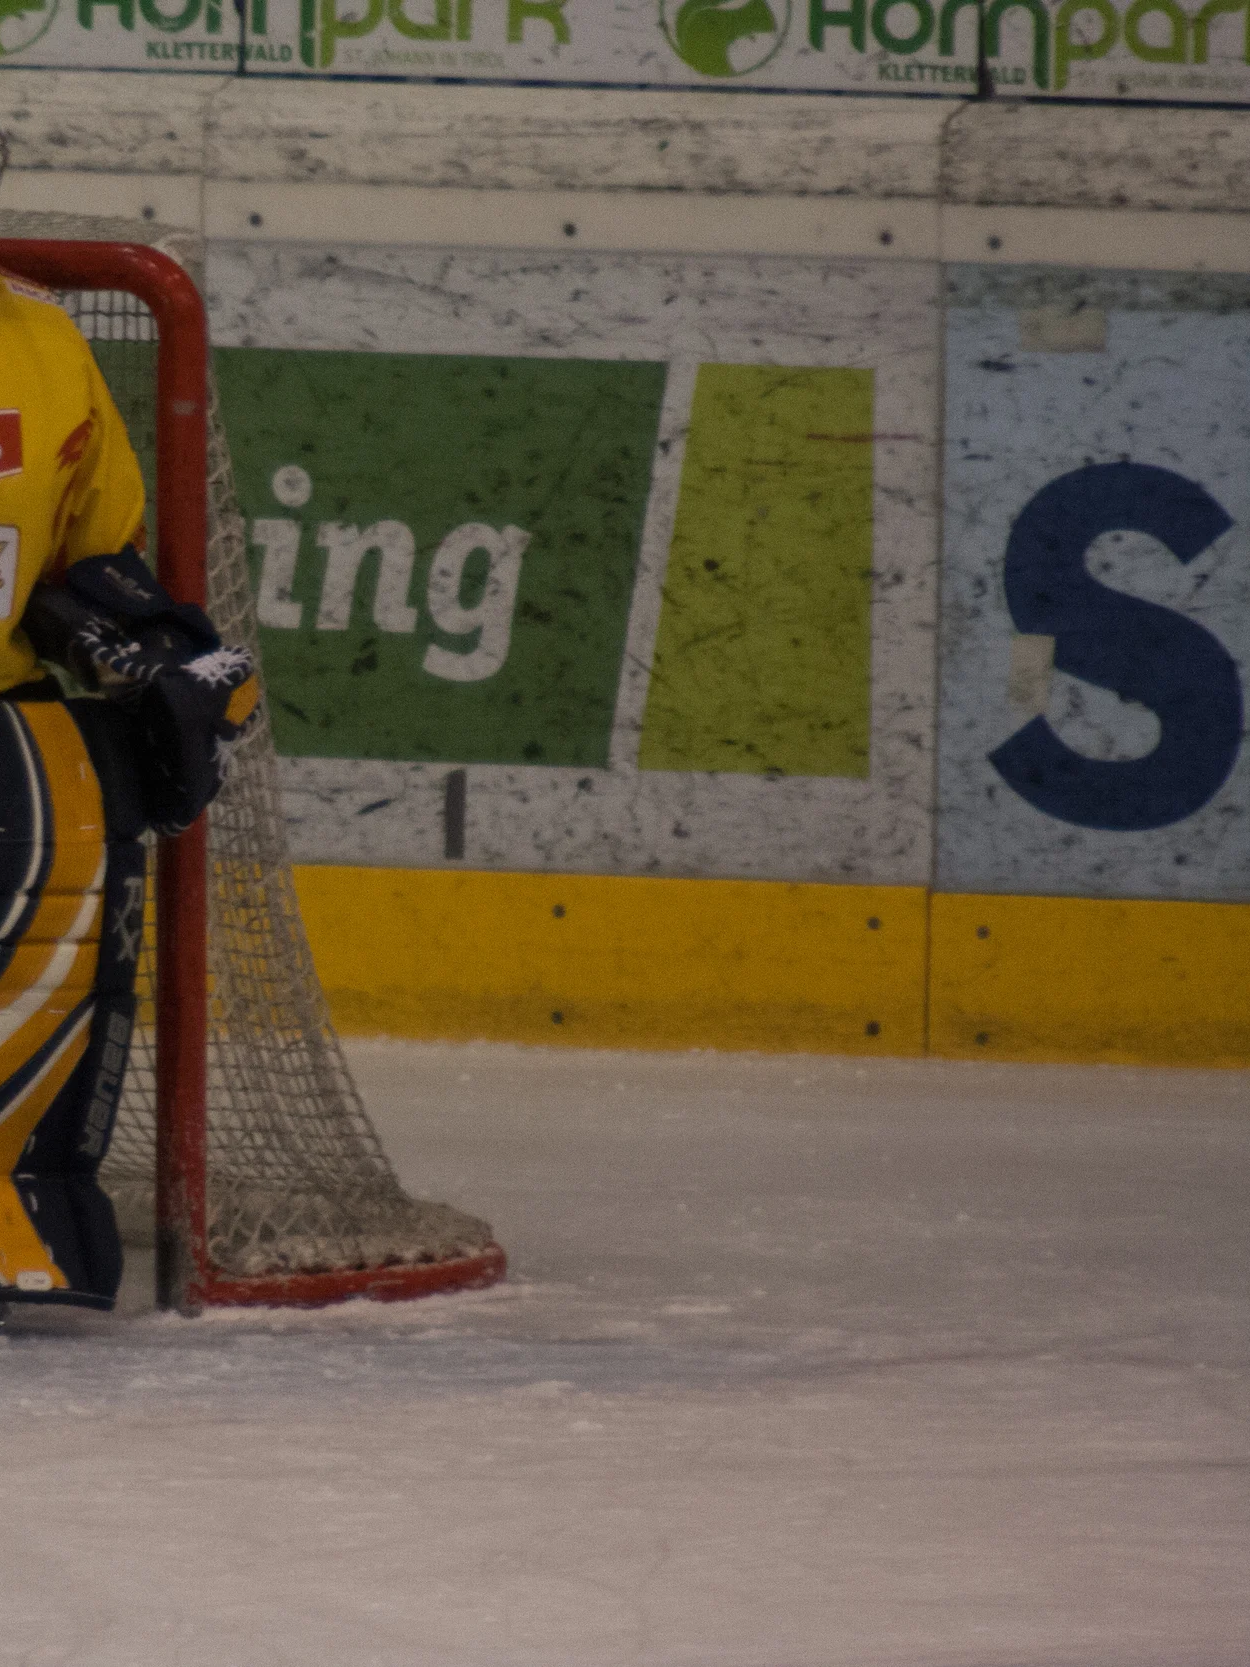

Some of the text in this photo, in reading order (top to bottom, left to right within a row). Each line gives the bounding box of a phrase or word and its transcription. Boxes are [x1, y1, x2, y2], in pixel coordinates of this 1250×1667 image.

[146, 42, 292, 62] KLETTERWALD
[809, 0, 1250, 91] Hornpar
[986, 461, 1244, 832] S
